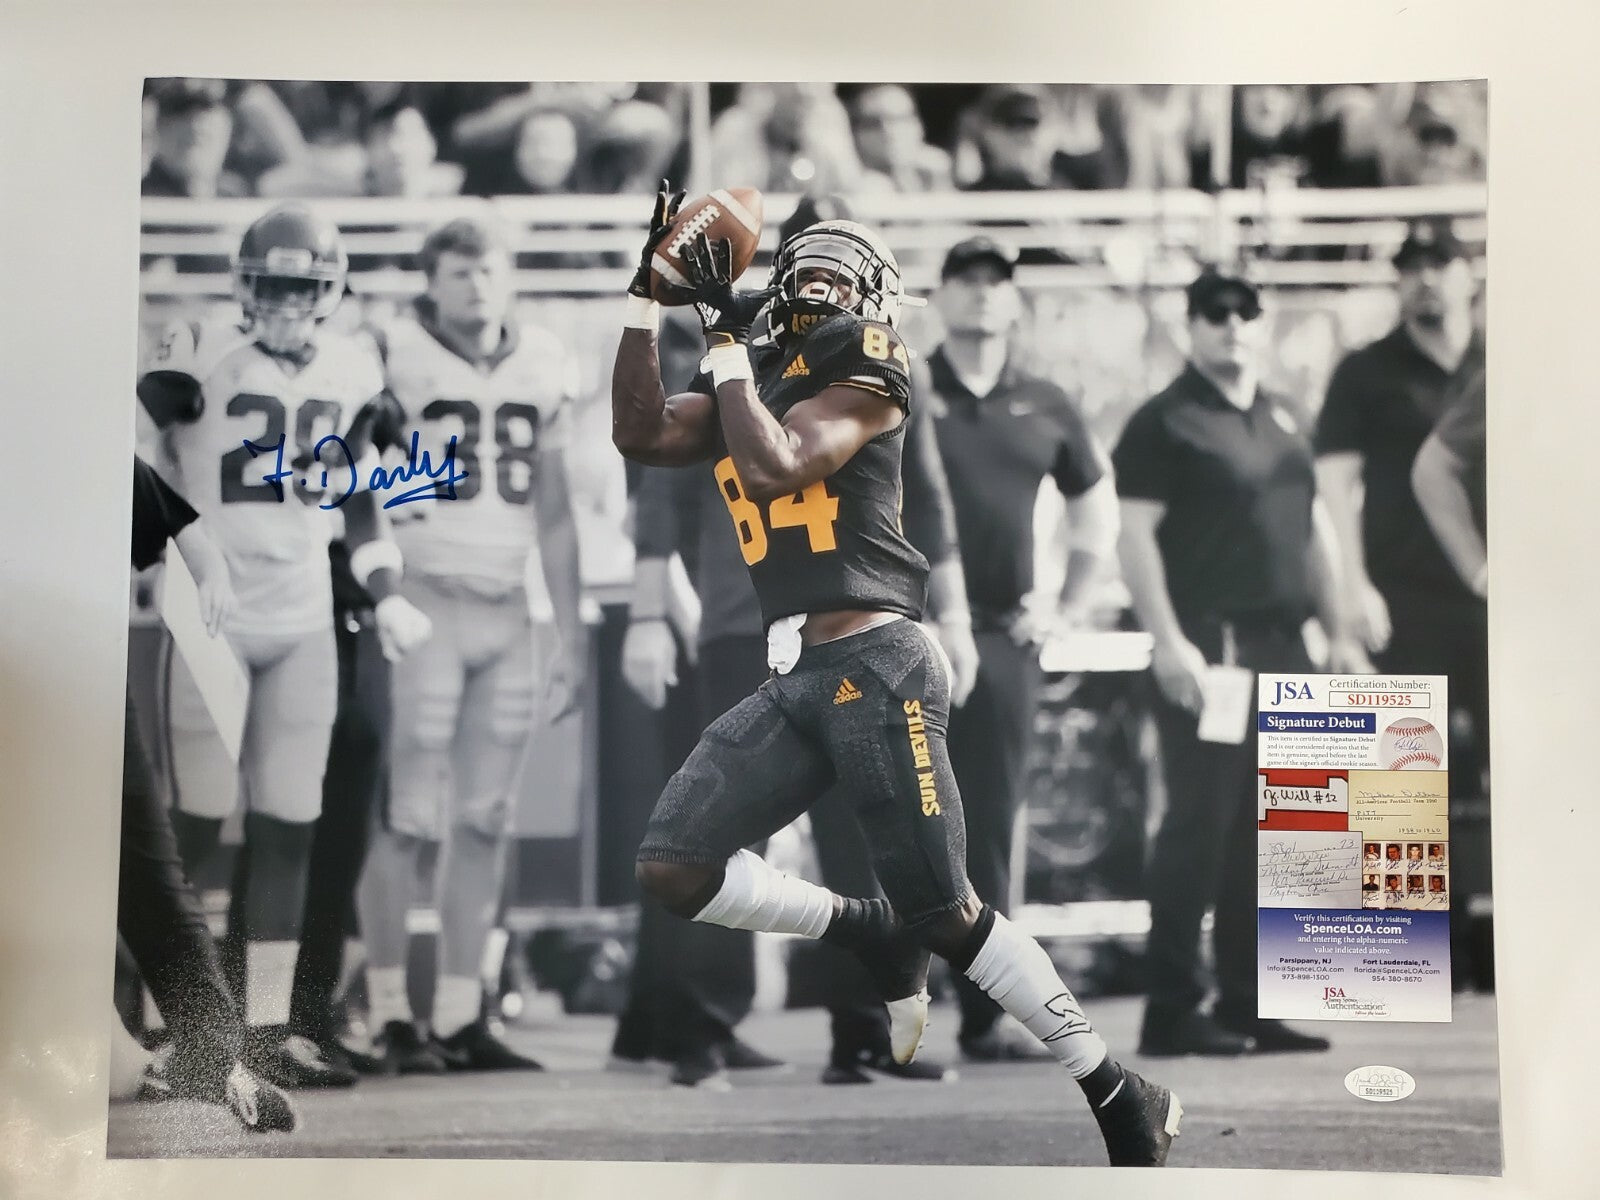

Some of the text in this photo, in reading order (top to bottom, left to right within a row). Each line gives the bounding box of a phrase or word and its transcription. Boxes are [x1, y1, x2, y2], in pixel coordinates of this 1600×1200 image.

[423, 400, 539, 505] 38
[714, 456, 840, 567] 84
[1329, 679, 1431, 690] Certification Number:
[833, 691, 863, 705] adidas
[1271, 681, 1315, 706] JSA
[1347, 694, 1412, 706] SD119525
[1267, 715, 1366, 730] Signature Debut
[904, 699, 941, 817] SUN DEVILS
[1294, 914, 1412, 925] Verify this certification by visiting
[1303, 923, 1402, 935] SpenceLOA.com
[1298, 935, 1311, 943] and
[1312, 936, 1342, 945] entering
[1356, 936, 1409, 945] alpha-numeric
[1314, 946, 1391, 954] value indicated above.
[1279, 957, 1321, 965] Parsippany,
[1281, 973, 1330, 981] 973-898-1300
[1353, 967, 1441, 975] florida@SpenceLOA.com
[1322, 987, 1347, 1001] JSA
